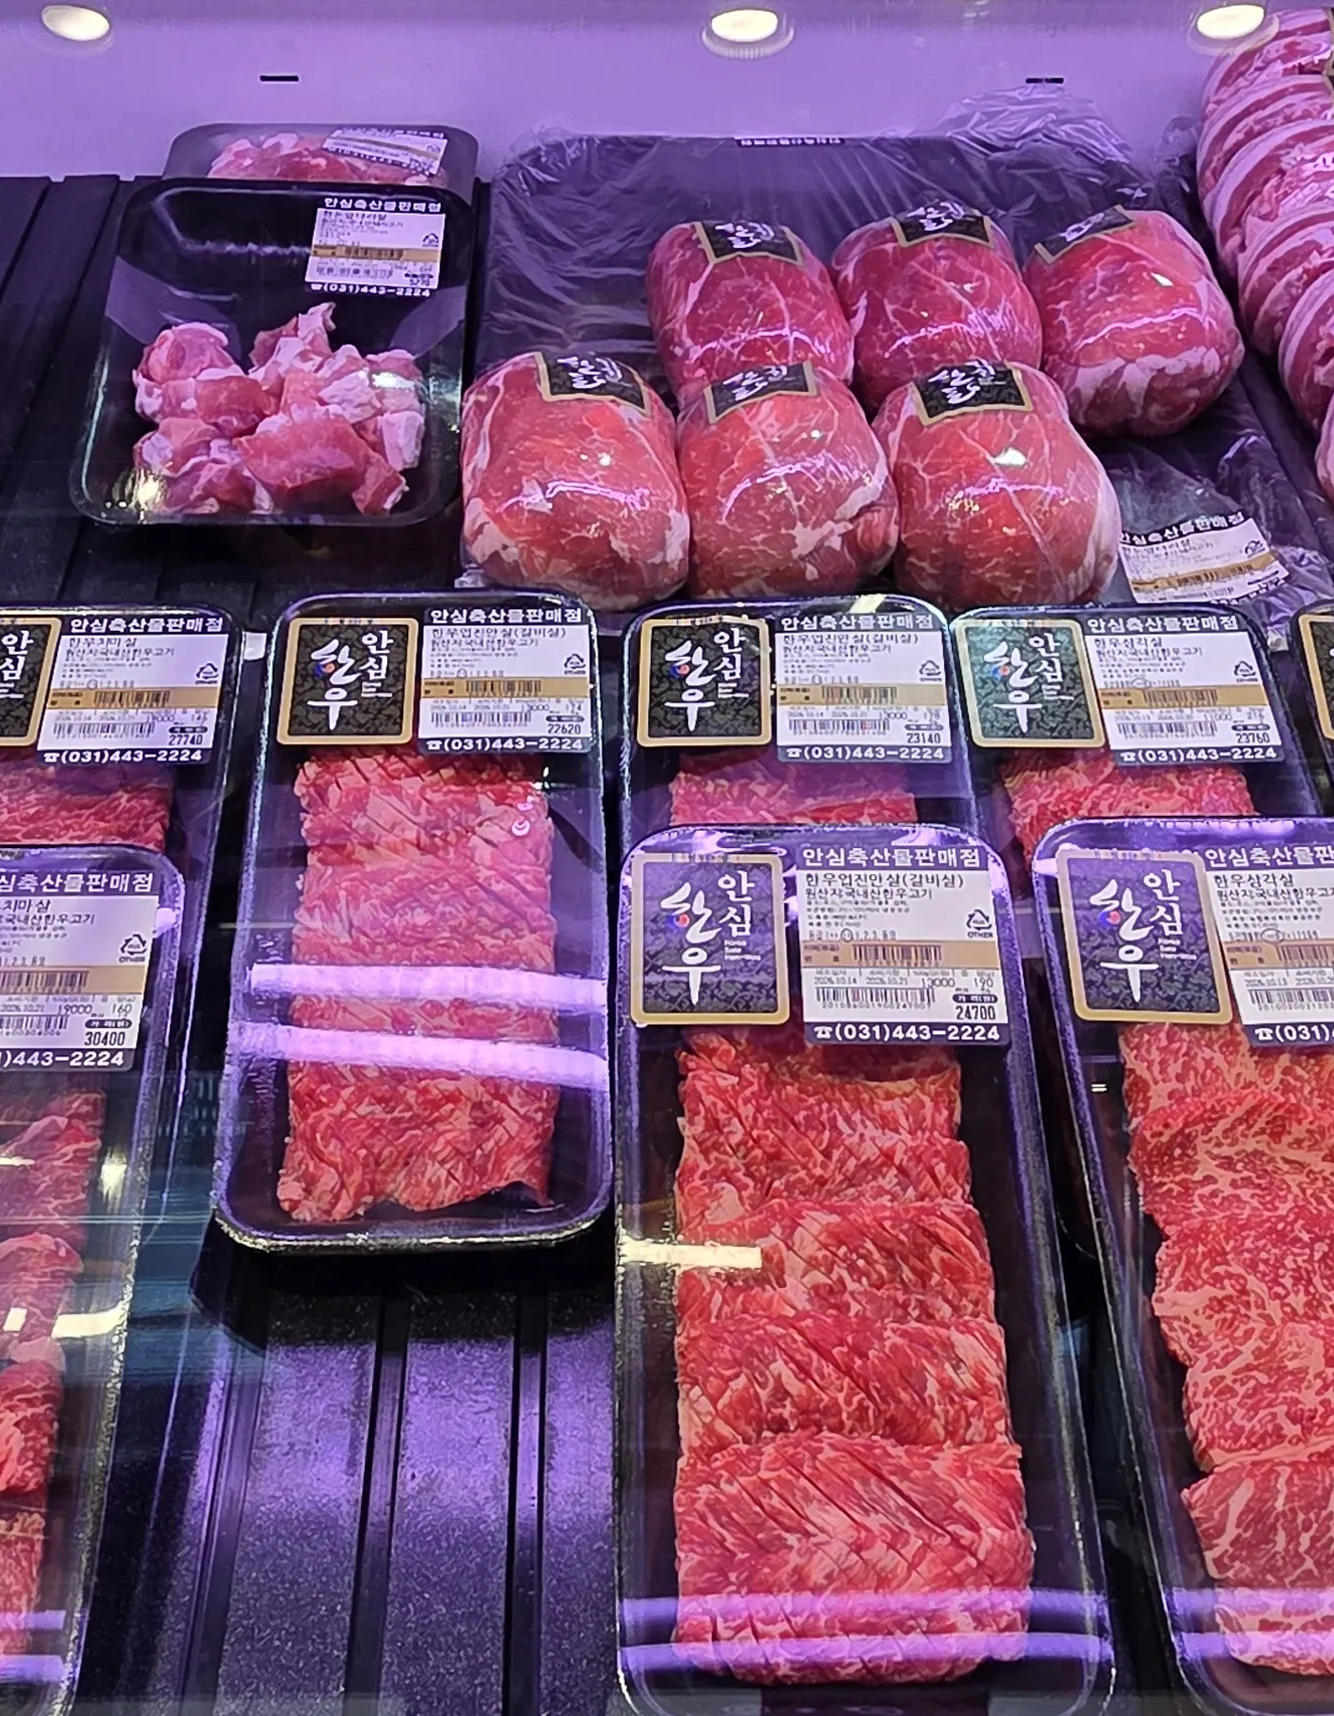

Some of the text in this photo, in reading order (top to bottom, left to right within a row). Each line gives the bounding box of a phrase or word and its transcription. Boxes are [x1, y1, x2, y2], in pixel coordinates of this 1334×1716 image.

[307, 638, 362, 731] 한우
[665, 640, 716, 732] 한우
[984, 641, 1043, 733] 한우
[548, 723, 581, 735] 22620
[168, 734, 203, 746] 27740
[444, 738, 583, 751] (031)443-2224
[907, 733, 941, 745] 23140
[1236, 733, 1270, 744] 23760
[61, 750, 202, 763] (031)443-2224
[804, 747, 944, 761] (031)443-2224
[1138, 748, 1277, 762] (031)443-2224
[802, 847, 981, 868] 안심축산물판매점
[967, 931, 994, 939] OTHER
[1090, 879, 1159, 1002] 한우
[660, 882, 722, 1006] 한우
[921, 977, 955, 988] 13000
[973, 977, 994, 988] 190
[955, 1005, 996, 1021] 24700
[84, 1031, 126, 1046] 30400
[835, 1024, 1000, 1042] (031)443-2224
